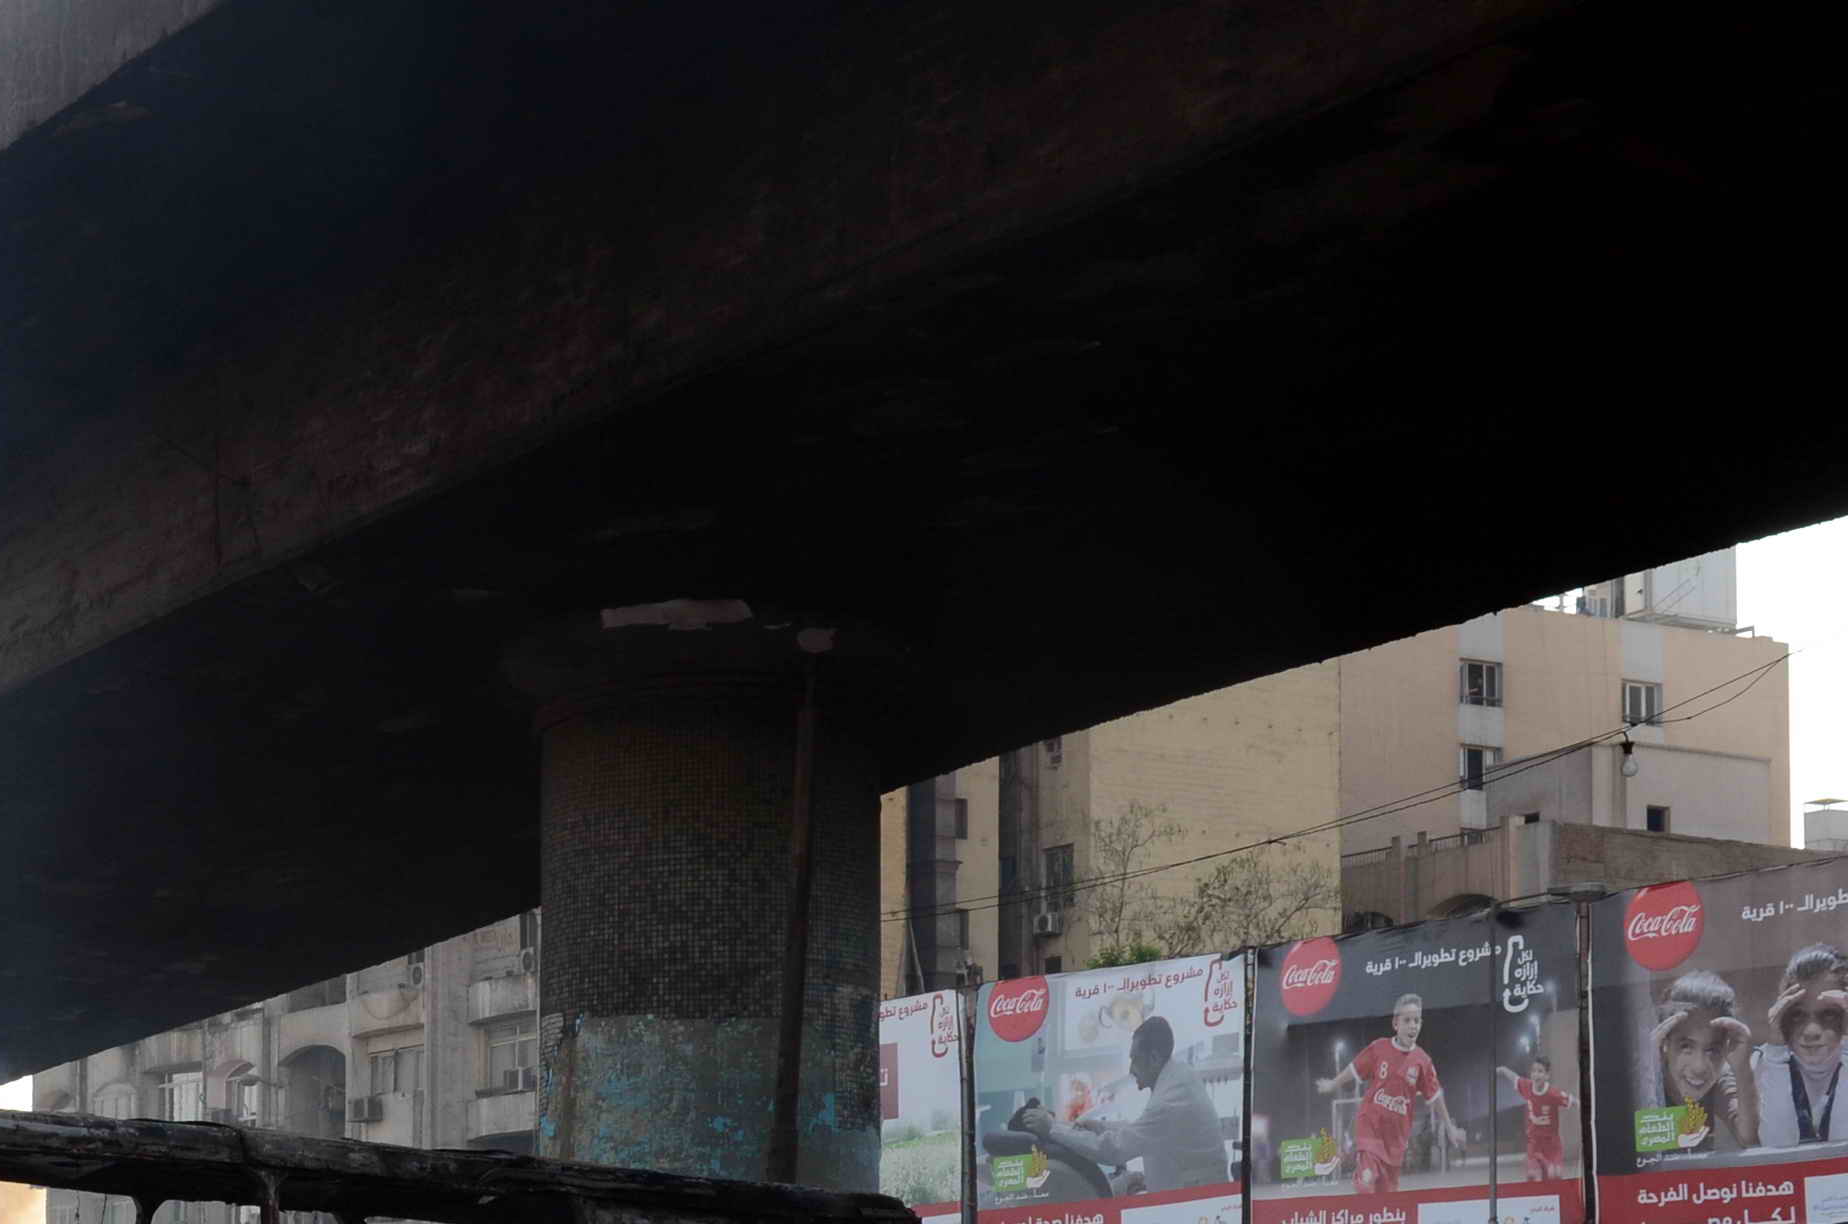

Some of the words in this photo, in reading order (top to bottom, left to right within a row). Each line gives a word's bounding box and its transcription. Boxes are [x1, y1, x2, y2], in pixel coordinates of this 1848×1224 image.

[1741, 903, 1775, 921] قرية
[1365, 958, 1391, 975] قرية
[1165, 966, 1204, 988] مشروع
[1075, 986, 1100, 999] قرية
[1513, 980, 1544, 998] حكاية
[1379, 1061, 1388, 1079] 8
[1637, 1184, 1688, 1206] الفرحة
[1692, 1183, 1737, 1204] نوصل
[1741, 1180, 1794, 1197] هدفنا
